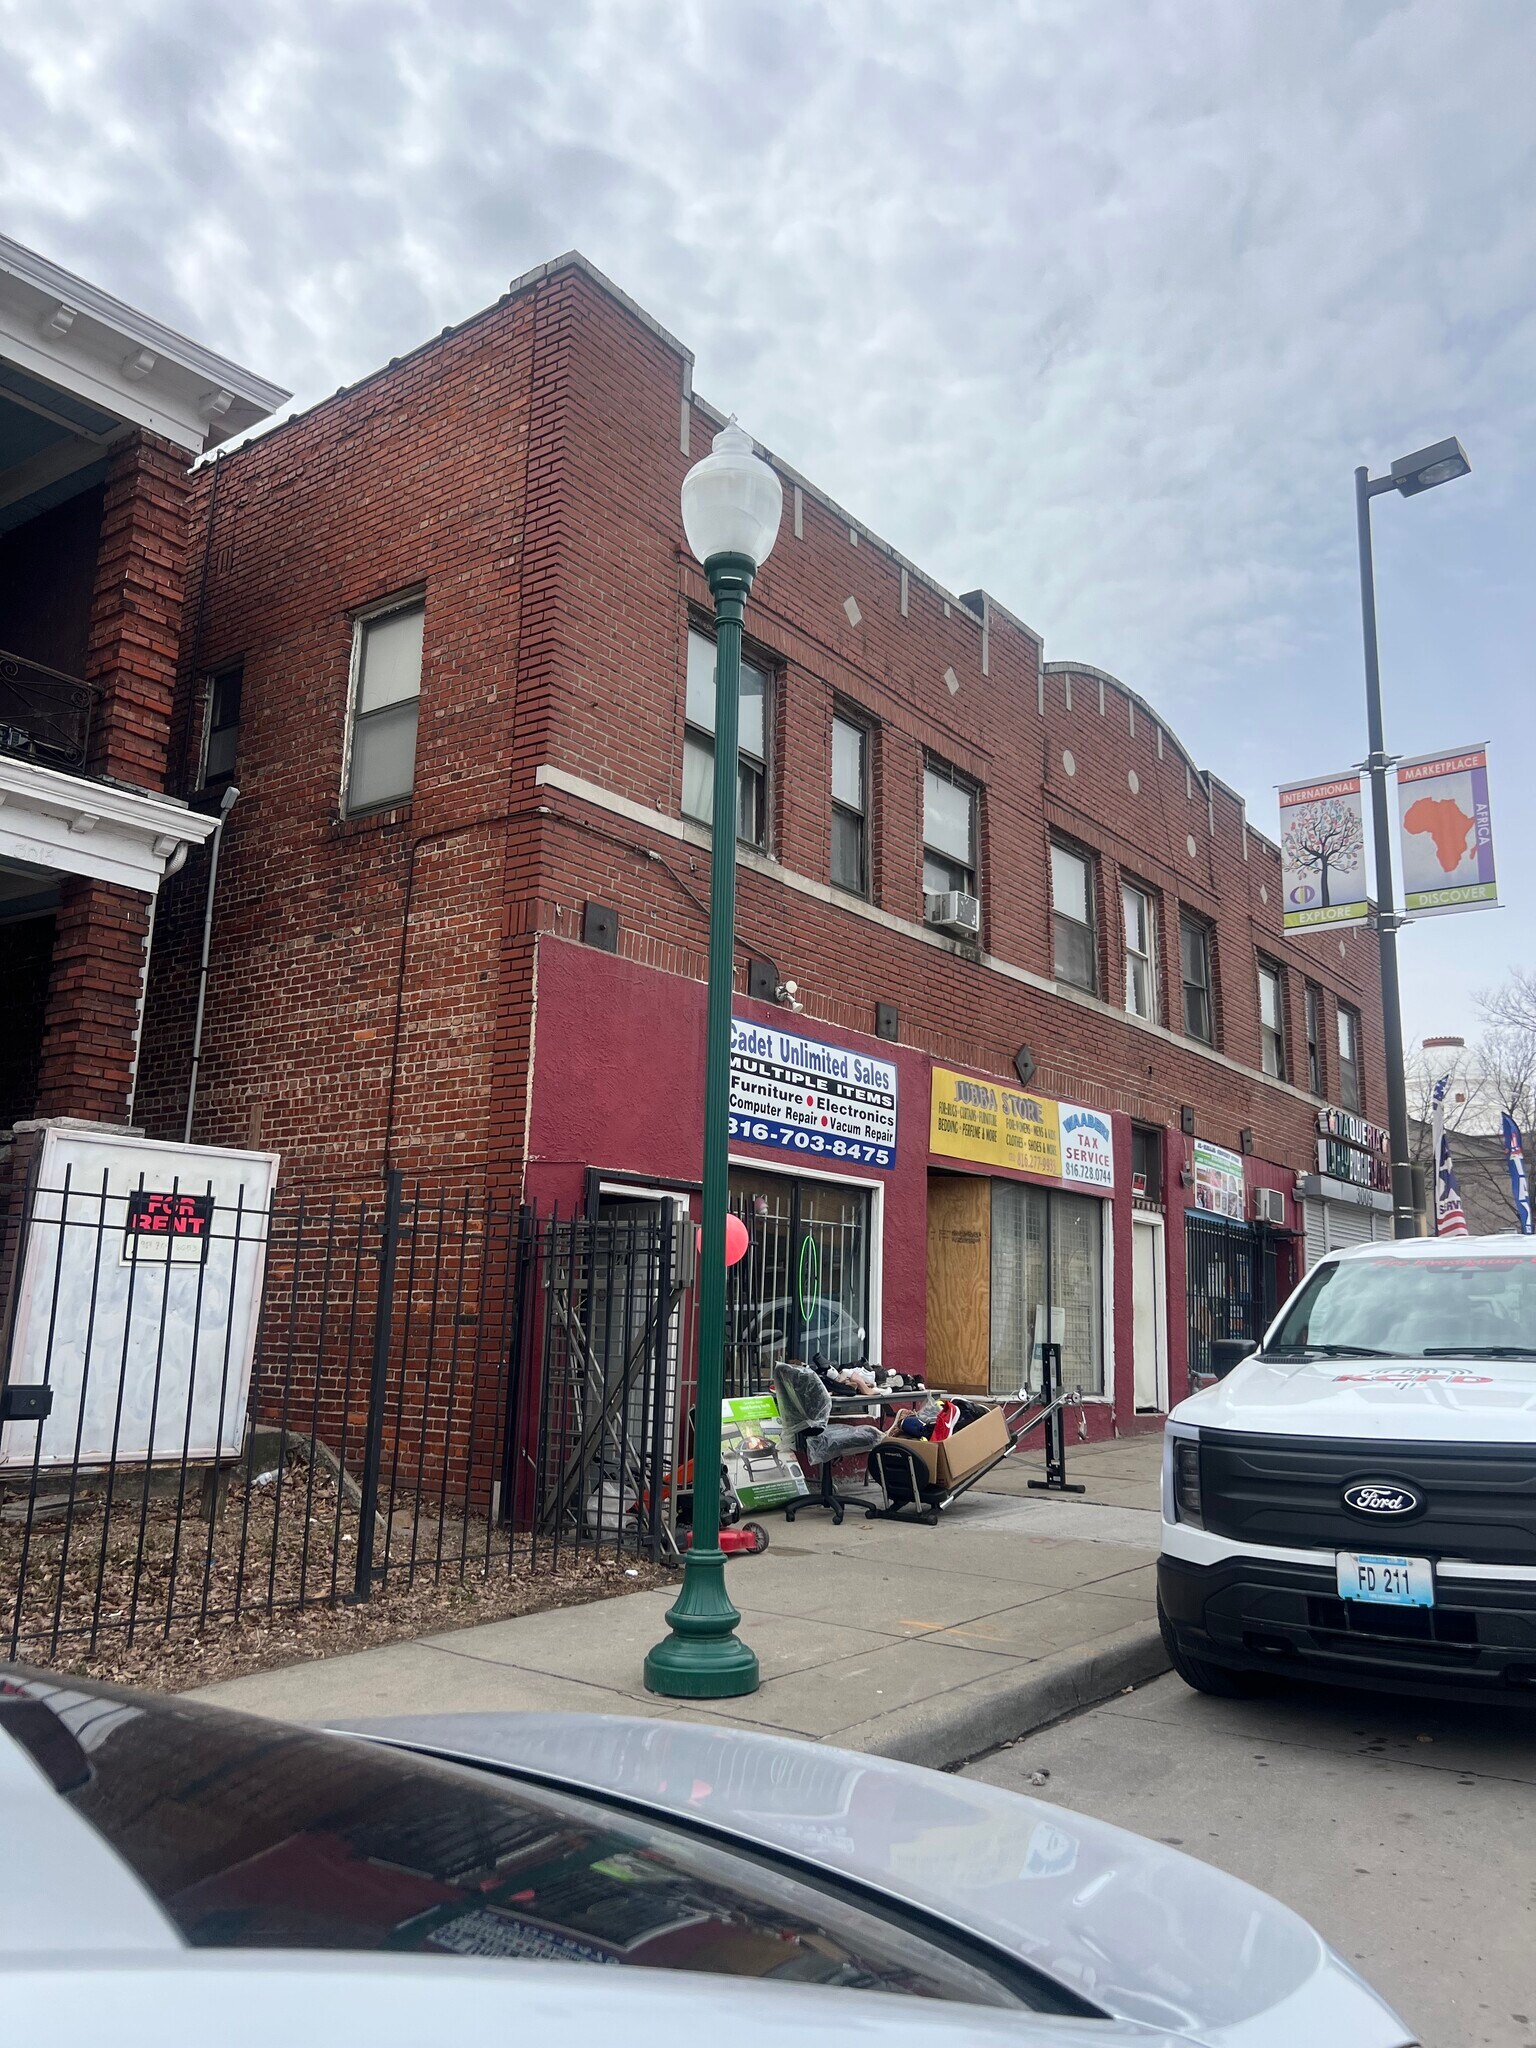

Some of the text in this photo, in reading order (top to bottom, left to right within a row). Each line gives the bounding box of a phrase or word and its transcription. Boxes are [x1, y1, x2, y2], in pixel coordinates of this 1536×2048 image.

[1405, 756, 1478, 780] MARKETPLACE
[1282, 782, 1354, 804] INTERNATIONAL
[1475, 803, 1490, 846] AFRICA
[1419, 887, 1486, 906] DISCOVER
[1299, 906, 1351, 924] EXPLORE
[780, 1037, 848, 1079] Unlimited
[854, 1059, 889, 1090] Sales
[731, 1056, 894, 1108] MULTIPLE ITEMS
[731, 1076, 894, 1127] Furniture Electronics
[953, 1080, 1044, 1124] JUBBA STORE
[729, 1094, 893, 1143] Computer Repair Vacum Repair
[729, 1117, 889, 1165] 816-703-8475
[1078, 1134, 1099, 1149] TAX
[1336, 1110, 1381, 1151] TAQUERIA
[1066, 1147, 1110, 1167] SERVICE
[1065, 1162, 1111, 1183] 816.728.0744
[148, 1194, 196, 1216] FOR
[1356, 1187, 1373, 1207] 3009
[132, 1213, 205, 1234] RENT
[1332, 1374, 1494, 1384] KCFD
[1356, 1488, 1403, 1510] Ford
[1358, 1566, 1410, 1595] FD 211
